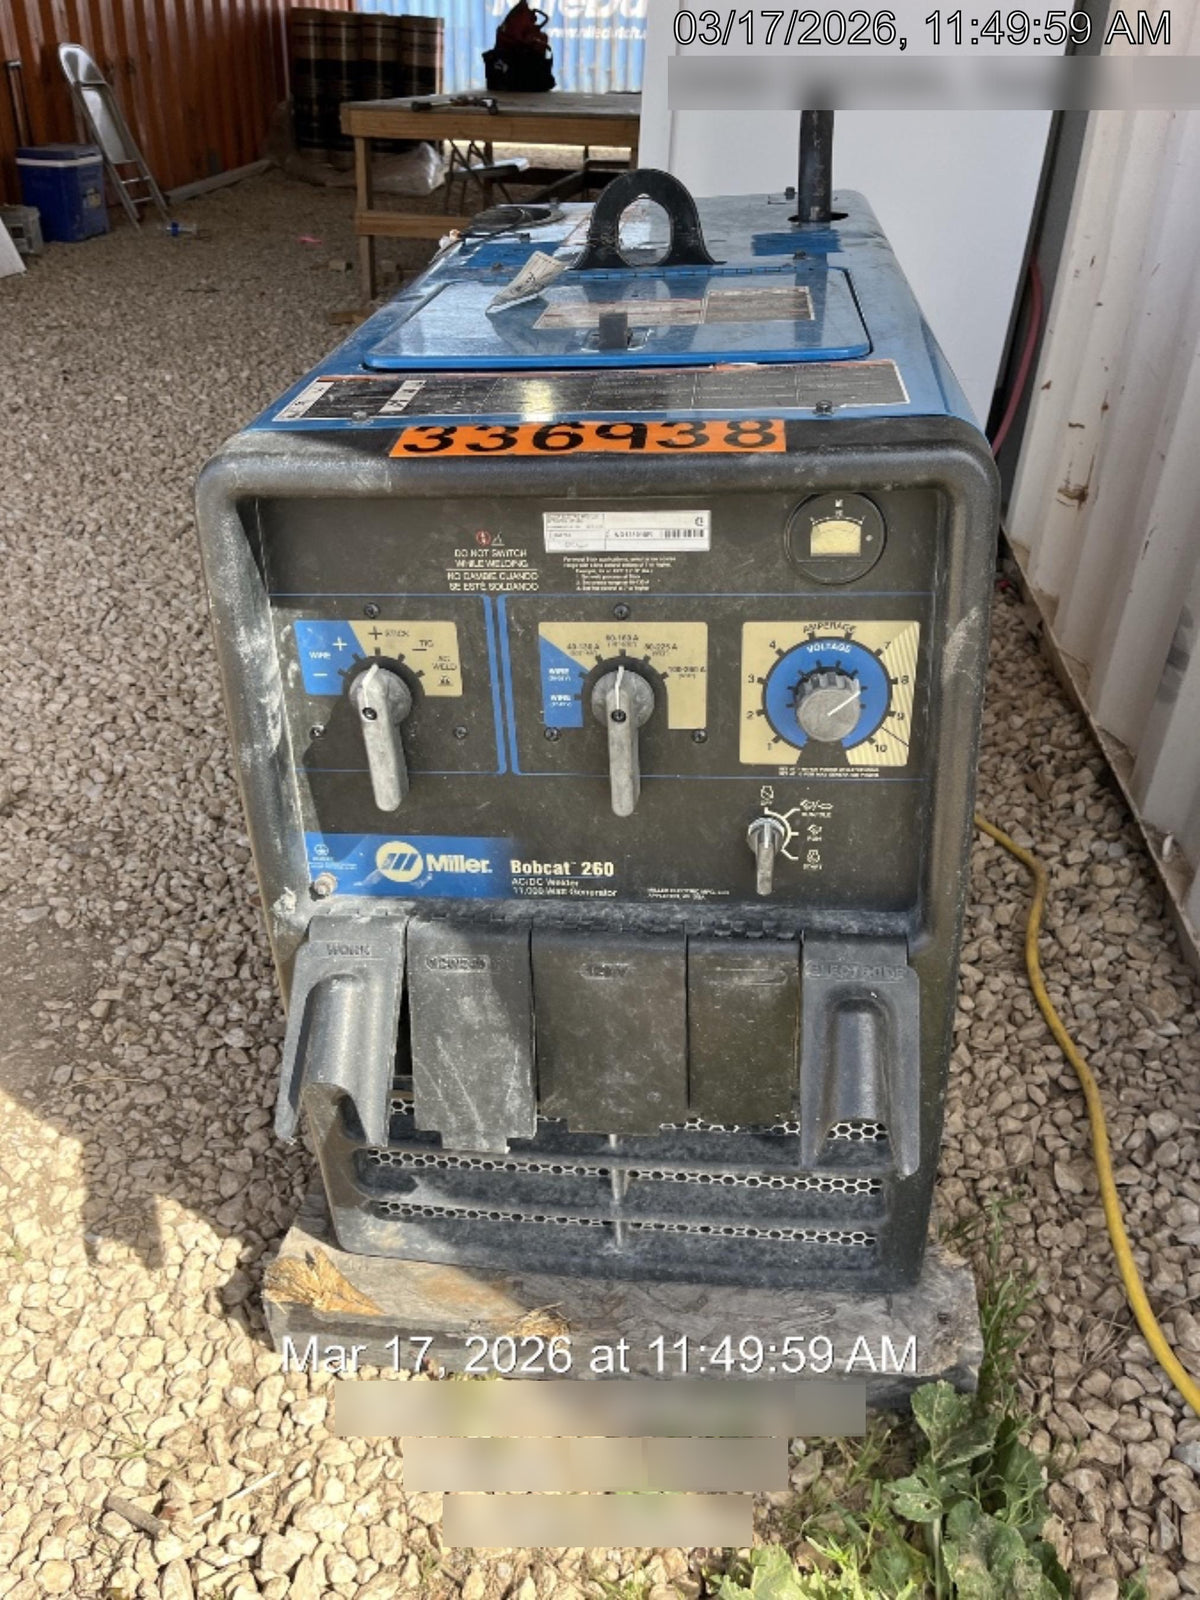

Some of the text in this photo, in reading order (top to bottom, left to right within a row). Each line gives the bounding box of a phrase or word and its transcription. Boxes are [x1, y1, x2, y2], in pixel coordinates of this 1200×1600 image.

[403, 420, 776, 453] 336938
[454, 549, 526, 557] DO NOT SWITCH
[769, 640, 777, 649] 4
[748, 675, 755, 683] 3
[902, 675, 909, 684] 8
[747, 711, 754, 719] 2
[897, 712, 905, 721] 9
[875, 743, 888, 753] 10
[581, 861, 615, 877] 260
[326, 944, 372, 956] WORK
